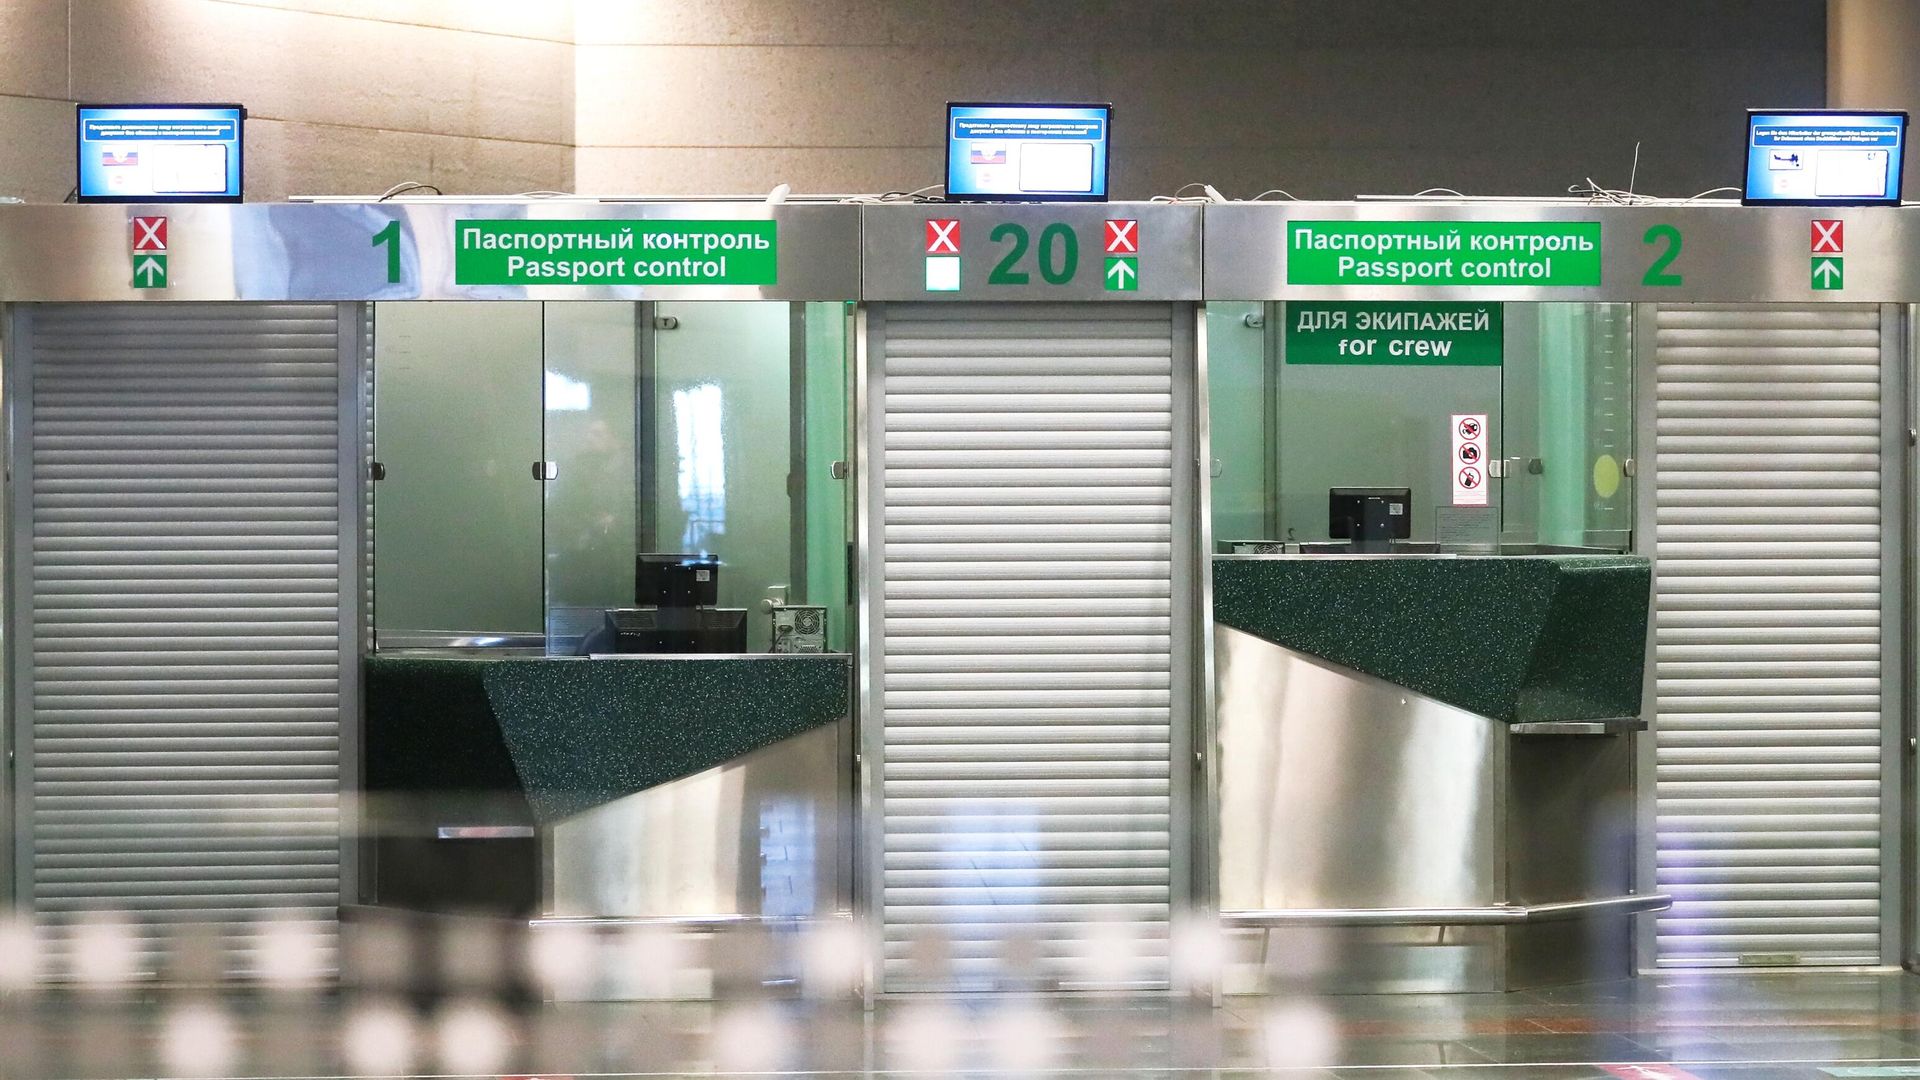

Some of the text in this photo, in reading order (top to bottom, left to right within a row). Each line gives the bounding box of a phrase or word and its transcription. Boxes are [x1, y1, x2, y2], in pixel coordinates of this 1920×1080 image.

[371, 220, 403, 284] 1
[463, 227, 770, 253] Паспортный контроль
[1295, 229, 1594, 254] Паспортный контроль
[988, 222, 1079, 285] 20
[1642, 224, 1683, 286] 2
[508, 256, 726, 282] Passport control
[1338, 256, 1552, 283] Passport control
[1297, 308, 1489, 333] ДЛЯ ЭКИПАЖЕЙ
[1338, 338, 1452, 357] for crew
